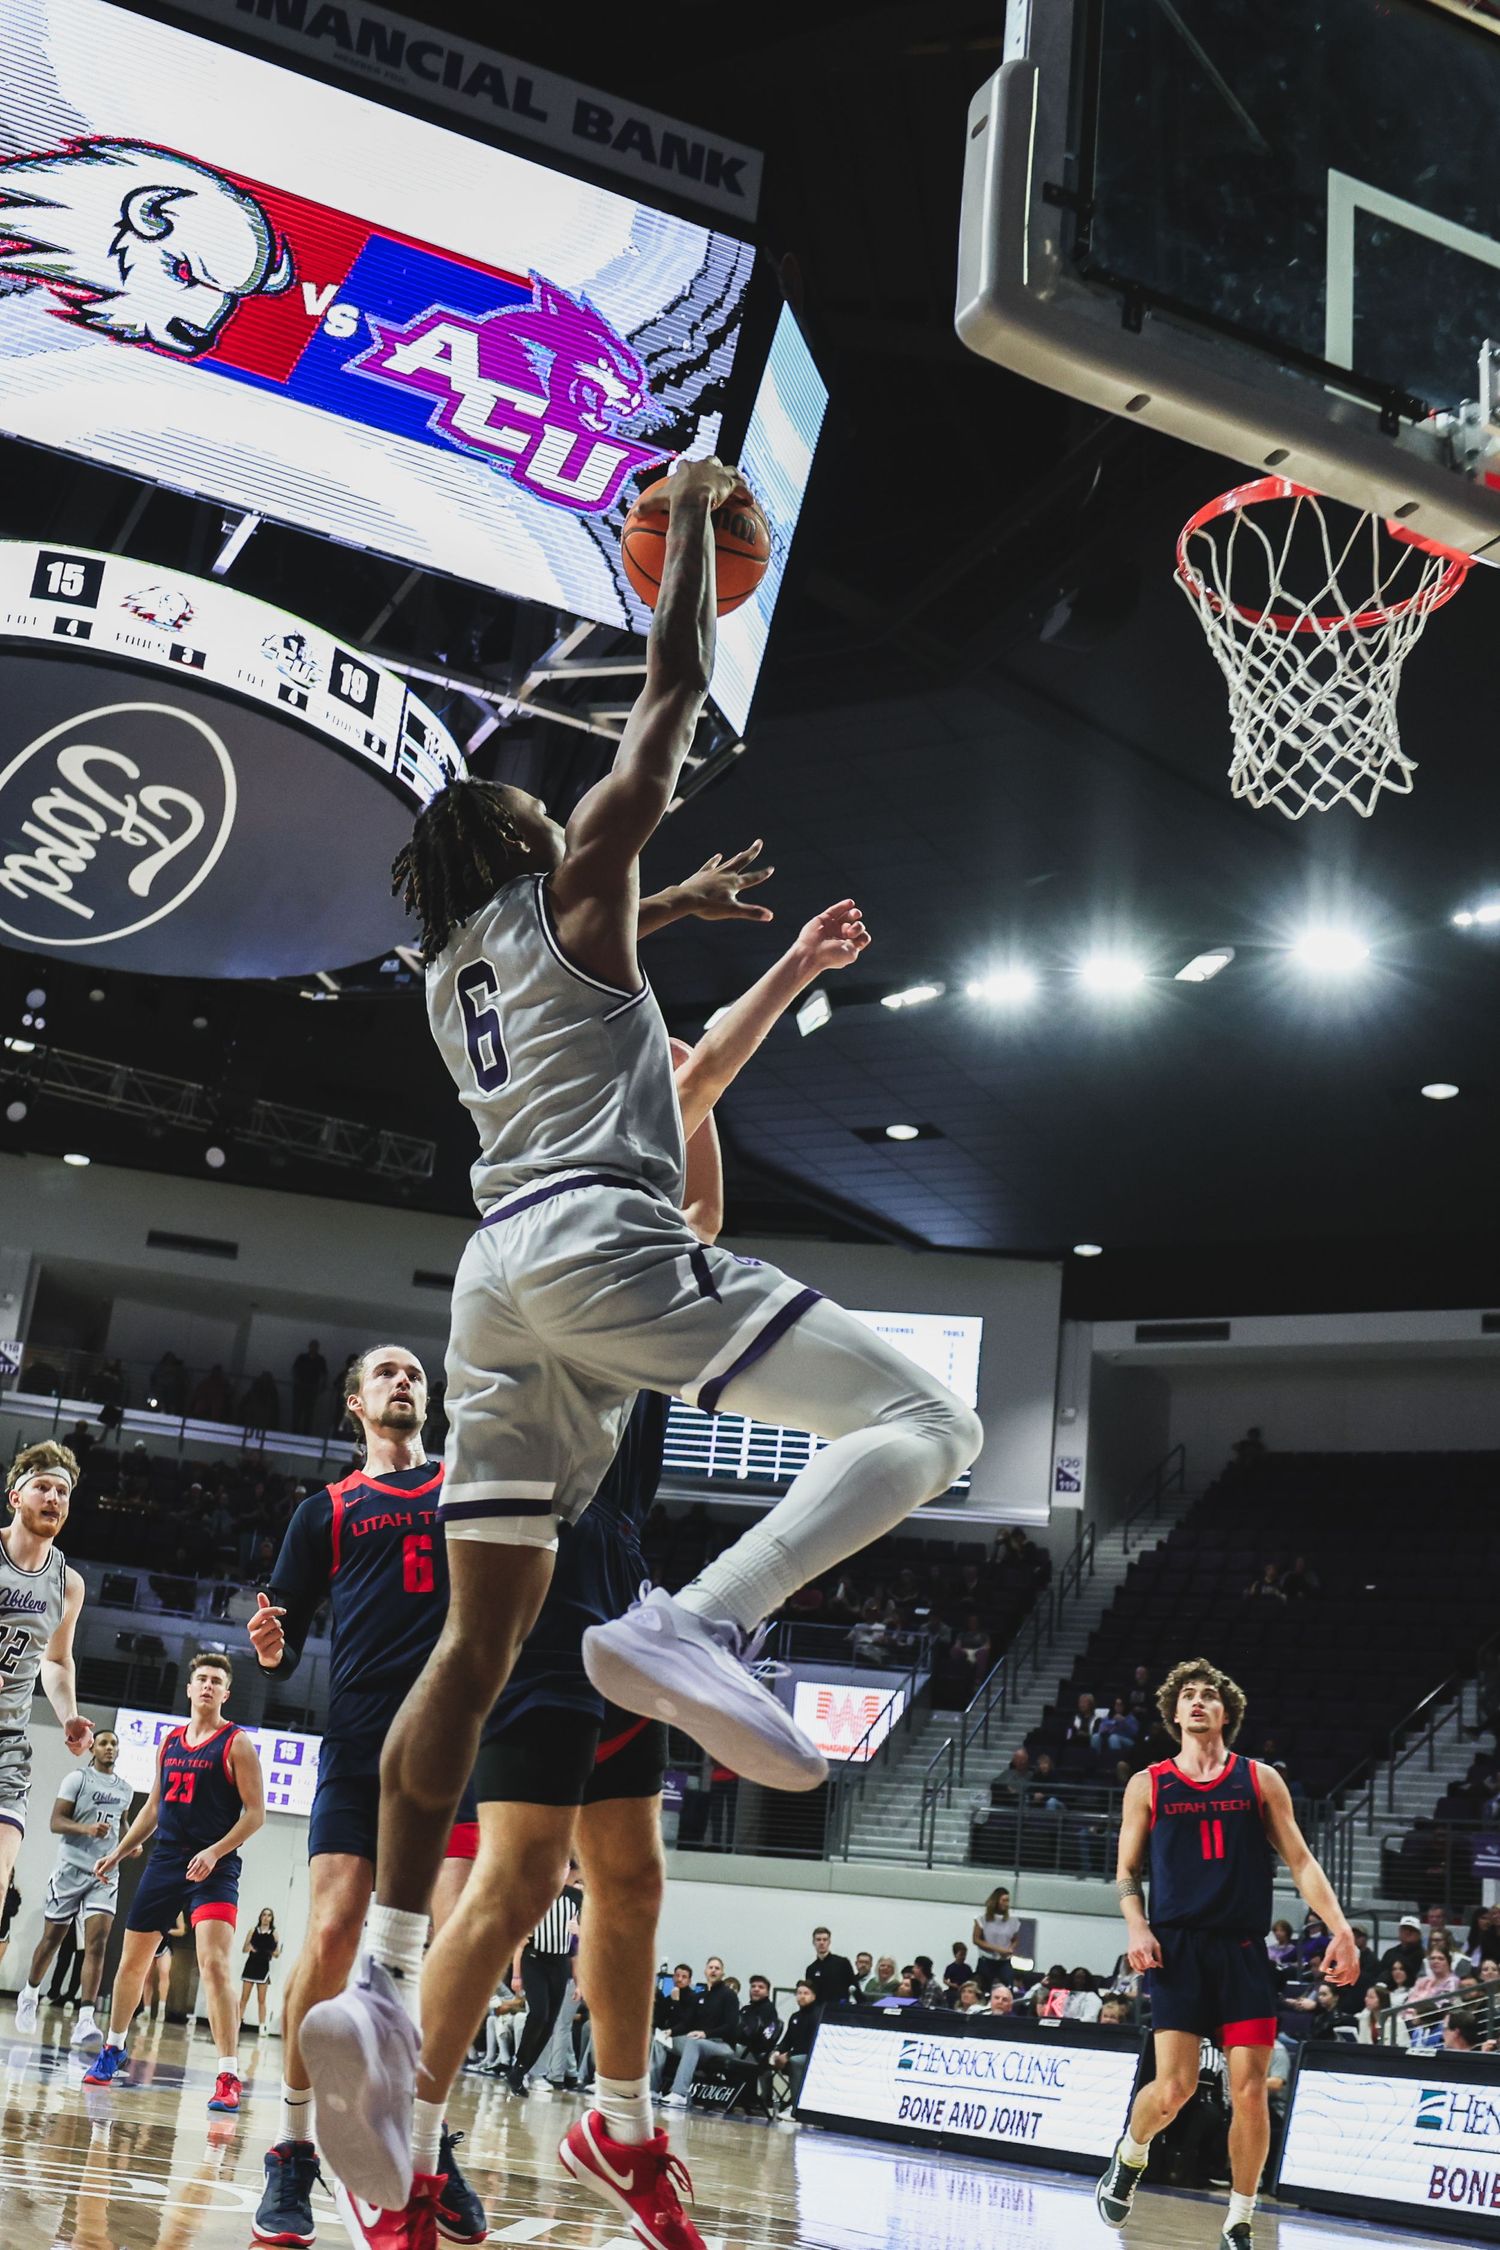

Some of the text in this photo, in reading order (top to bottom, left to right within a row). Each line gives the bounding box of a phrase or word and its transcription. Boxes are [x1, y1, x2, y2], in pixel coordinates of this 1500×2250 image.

[573, 97, 748, 197] BANK
[302, 281, 362, 338] VS
[382, 321, 630, 502] ACU
[46, 561, 86, 597] 15
[0, 744, 205, 920] Ford
[455, 957, 511, 1096] 6
[1060, 1458, 1080, 1468] 120
[352, 1512, 412, 1537] UTAH
[403, 1534, 434, 1592] 6
[278, 1741, 298, 1761] 15
[164, 1771, 196, 1803] 23
[1164, 1800, 1250, 1815] UTAH TECH
[1200, 1819, 1224, 1860] 11
[915, 2042, 1071, 2088] HENDRICK CLINIC
[699, 2084, 736, 2102] TOUGH
[898, 2095, 1043, 2140] BONE AND JOINT
[1428, 2165, 1500, 2209] BONE
